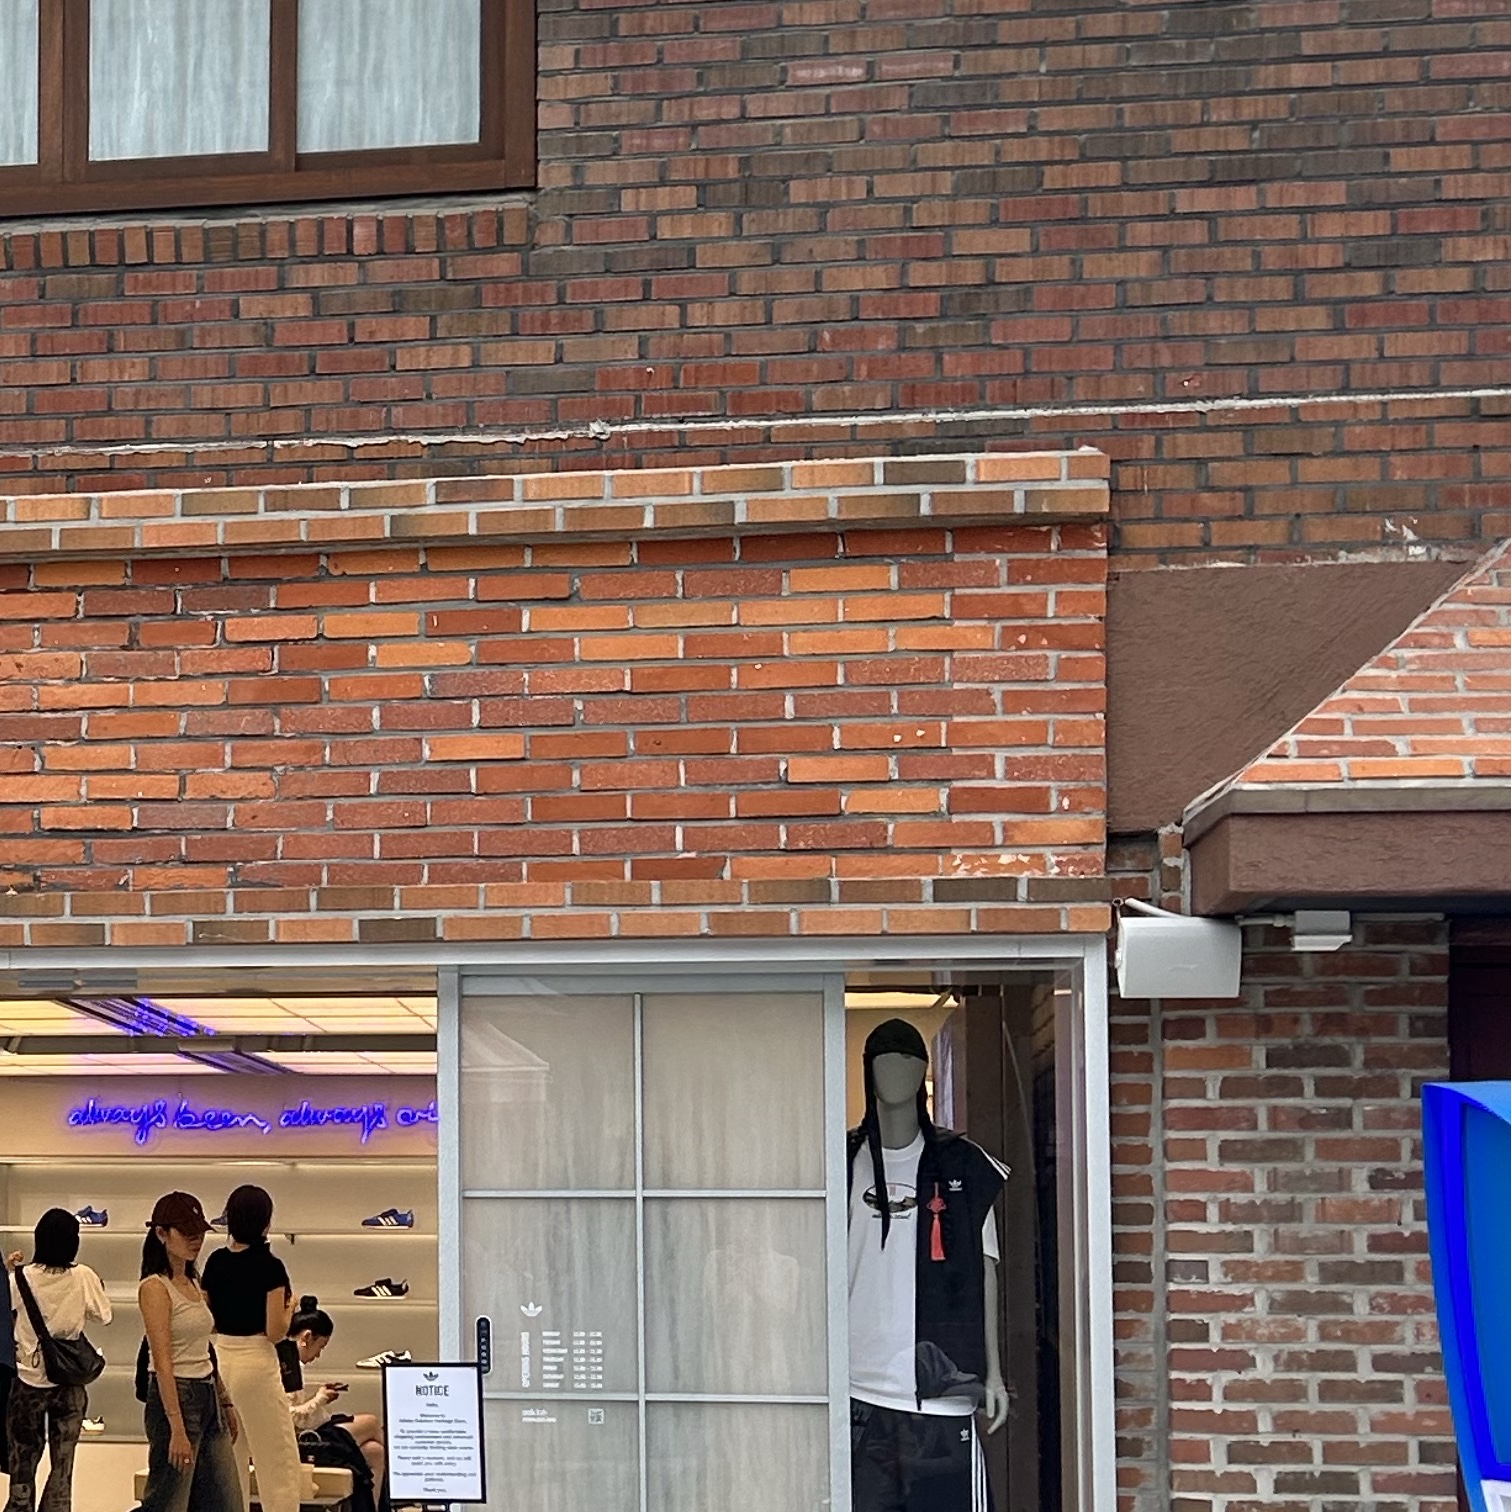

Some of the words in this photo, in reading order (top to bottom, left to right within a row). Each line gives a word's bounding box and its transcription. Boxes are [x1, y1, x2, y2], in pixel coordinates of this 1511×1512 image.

[68, 1098, 167, 1145] always
[279, 1101, 388, 1145] always
[396, 1101, 439, 1126] ori
[415, 1384, 450, 1397] NOTICE
